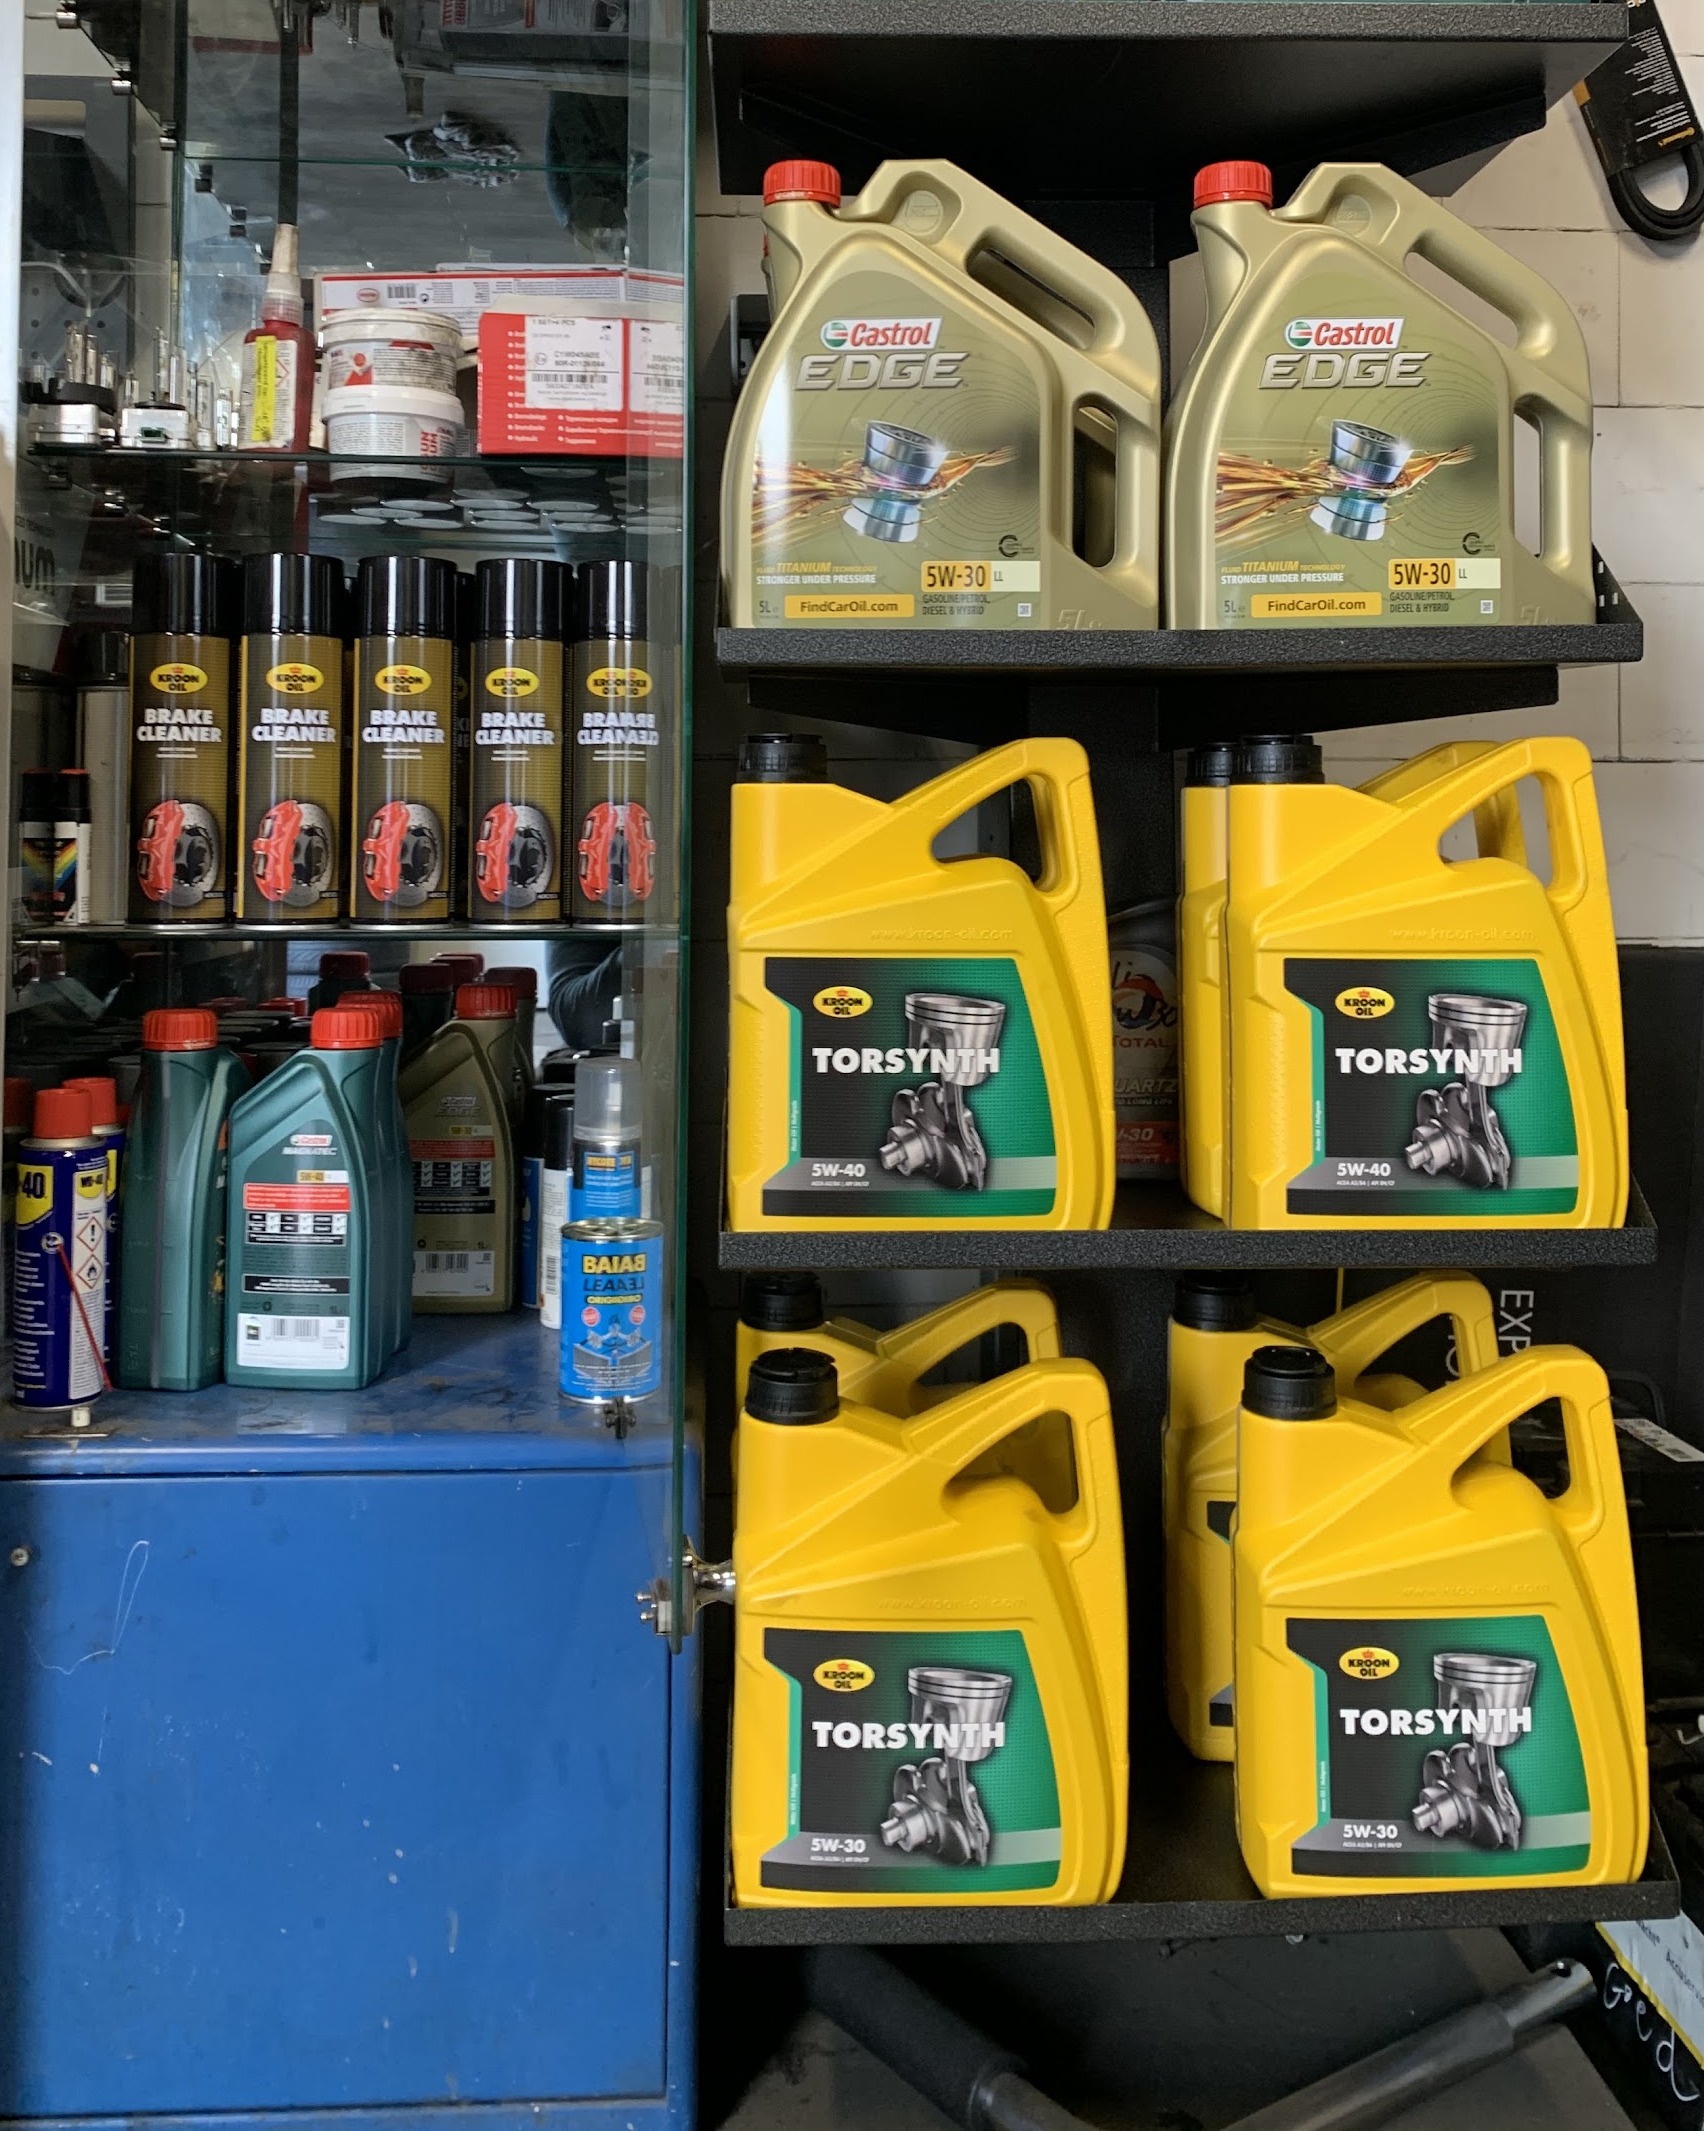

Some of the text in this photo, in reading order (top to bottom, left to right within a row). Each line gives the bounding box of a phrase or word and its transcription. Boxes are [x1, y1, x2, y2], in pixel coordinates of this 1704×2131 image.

[850, 321, 933, 348] Castrol
[1314, 321, 1395, 347] Castrol
[794, 353, 971, 391] EDGE
[1257, 352, 1432, 390] EDGE
[776, 562, 832, 574] TITANIUM
[1242, 560, 1300, 573] TITANIUM
[1300, 563, 1346, 572] TECHNOLOGY
[755, 573, 877, 585] STRONGER UNDER PRESSURE
[926, 564, 987, 588] 5W-30
[1220, 572, 1345, 585] STRONGER UNDER PRESSURE
[1393, 562, 1468, 586] 5W-30 LL
[758, 600, 772, 614] 5L
[800, 600, 899, 614] FindCarOil.com
[921, 604, 948, 616] DIESEL
[955, 604, 985, 616] HYBRID
[1223, 600, 1237, 613] 5L
[1267, 599, 1367, 612] FindCarOil.com
[1389, 601, 1450, 614] DIESEL & HYBRID
[157, 673, 201, 684] KROON
[274, 673, 317, 684] KROON
[167, 682, 188, 693] OIL
[286, 682, 305, 693] OIL
[144, 708, 214, 726] BRAKE
[260, 708, 330, 726] BRAKE
[369, 709, 438, 727] BRAKE
[480, 712, 547, 729] BRAKE
[136, 725, 223, 743] CLEANER
[251, 725, 337, 743] CLEANER
[361, 727, 446, 744] CLEANER
[474, 728, 555, 746] CLEANER
[821, 998, 864, 1008] KROON
[1343, 997, 1386, 1008] KROON
[832, 1006, 851, 1016] OIL
[1355, 1006, 1374, 1017] OIL
[811, 1047, 1001, 1075] TORSYNTH
[1335, 1047, 1523, 1075] TORSYNTH
[811, 1163, 866, 1178] 5W-40
[1336, 1162, 1392, 1177] 5W-40
[1347, 1658, 1391, 1668] KROON
[822, 1671, 865, 1681] KROON
[1359, 1667, 1379, 1678] OIL
[833, 1680, 853, 1690] OIL
[1339, 1706, 1533, 1736] TORSYNTH
[810, 1721, 1007, 1750] TORSYNTH
[1342, 1824, 1399, 1840] 5W-30
[810, 1838, 867, 1854] 5W-30
